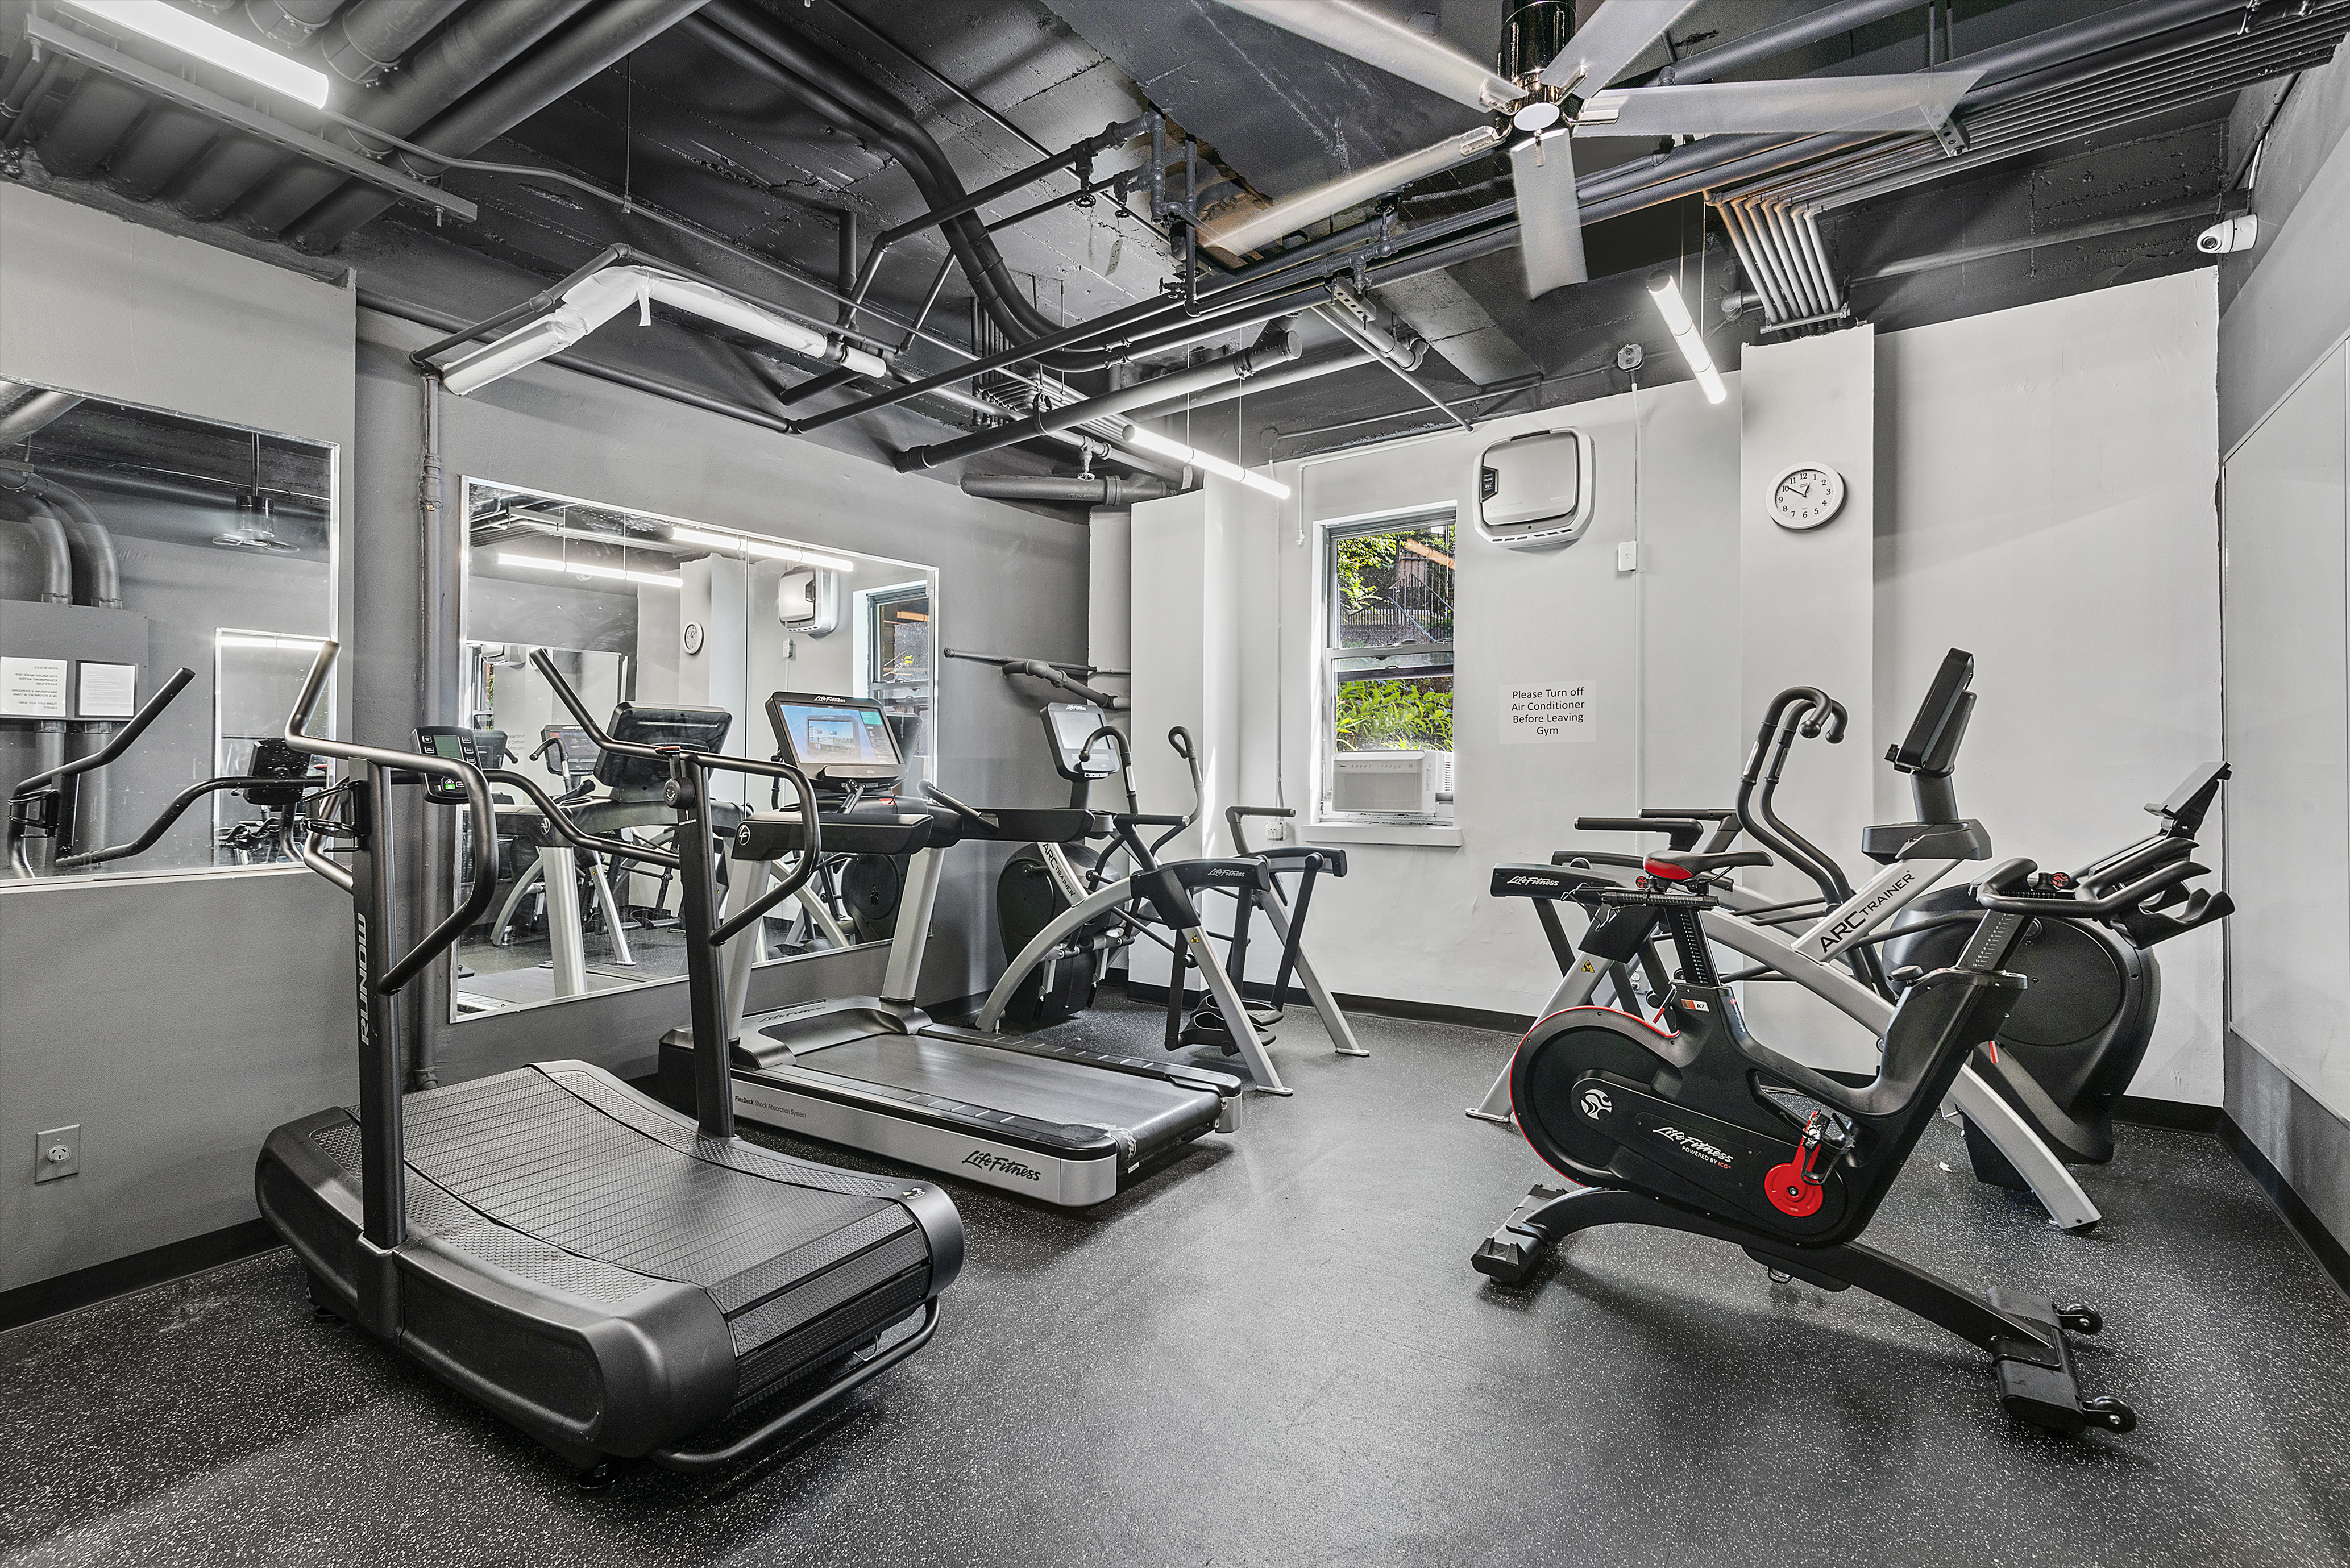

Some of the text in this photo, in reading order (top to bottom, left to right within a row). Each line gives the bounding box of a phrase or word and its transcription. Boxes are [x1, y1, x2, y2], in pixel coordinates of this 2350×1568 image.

[1513, 691, 1543, 699] Please
[1570, 687, 1584, 696] off
[1512, 701, 1585, 711] Air Conditioner
[1513, 713, 1584, 723] Before Leaving
[1537, 726, 1558, 737] Gym
[1042, 843, 1058, 869] ARC
[1820, 910, 1866, 953] ARC
[755, 1100, 767, 1109] Shock
[768, 1104, 790, 1114] Absorption
[791, 1109, 807, 1118] System
[1681, 1145, 1709, 1161] POWERED
